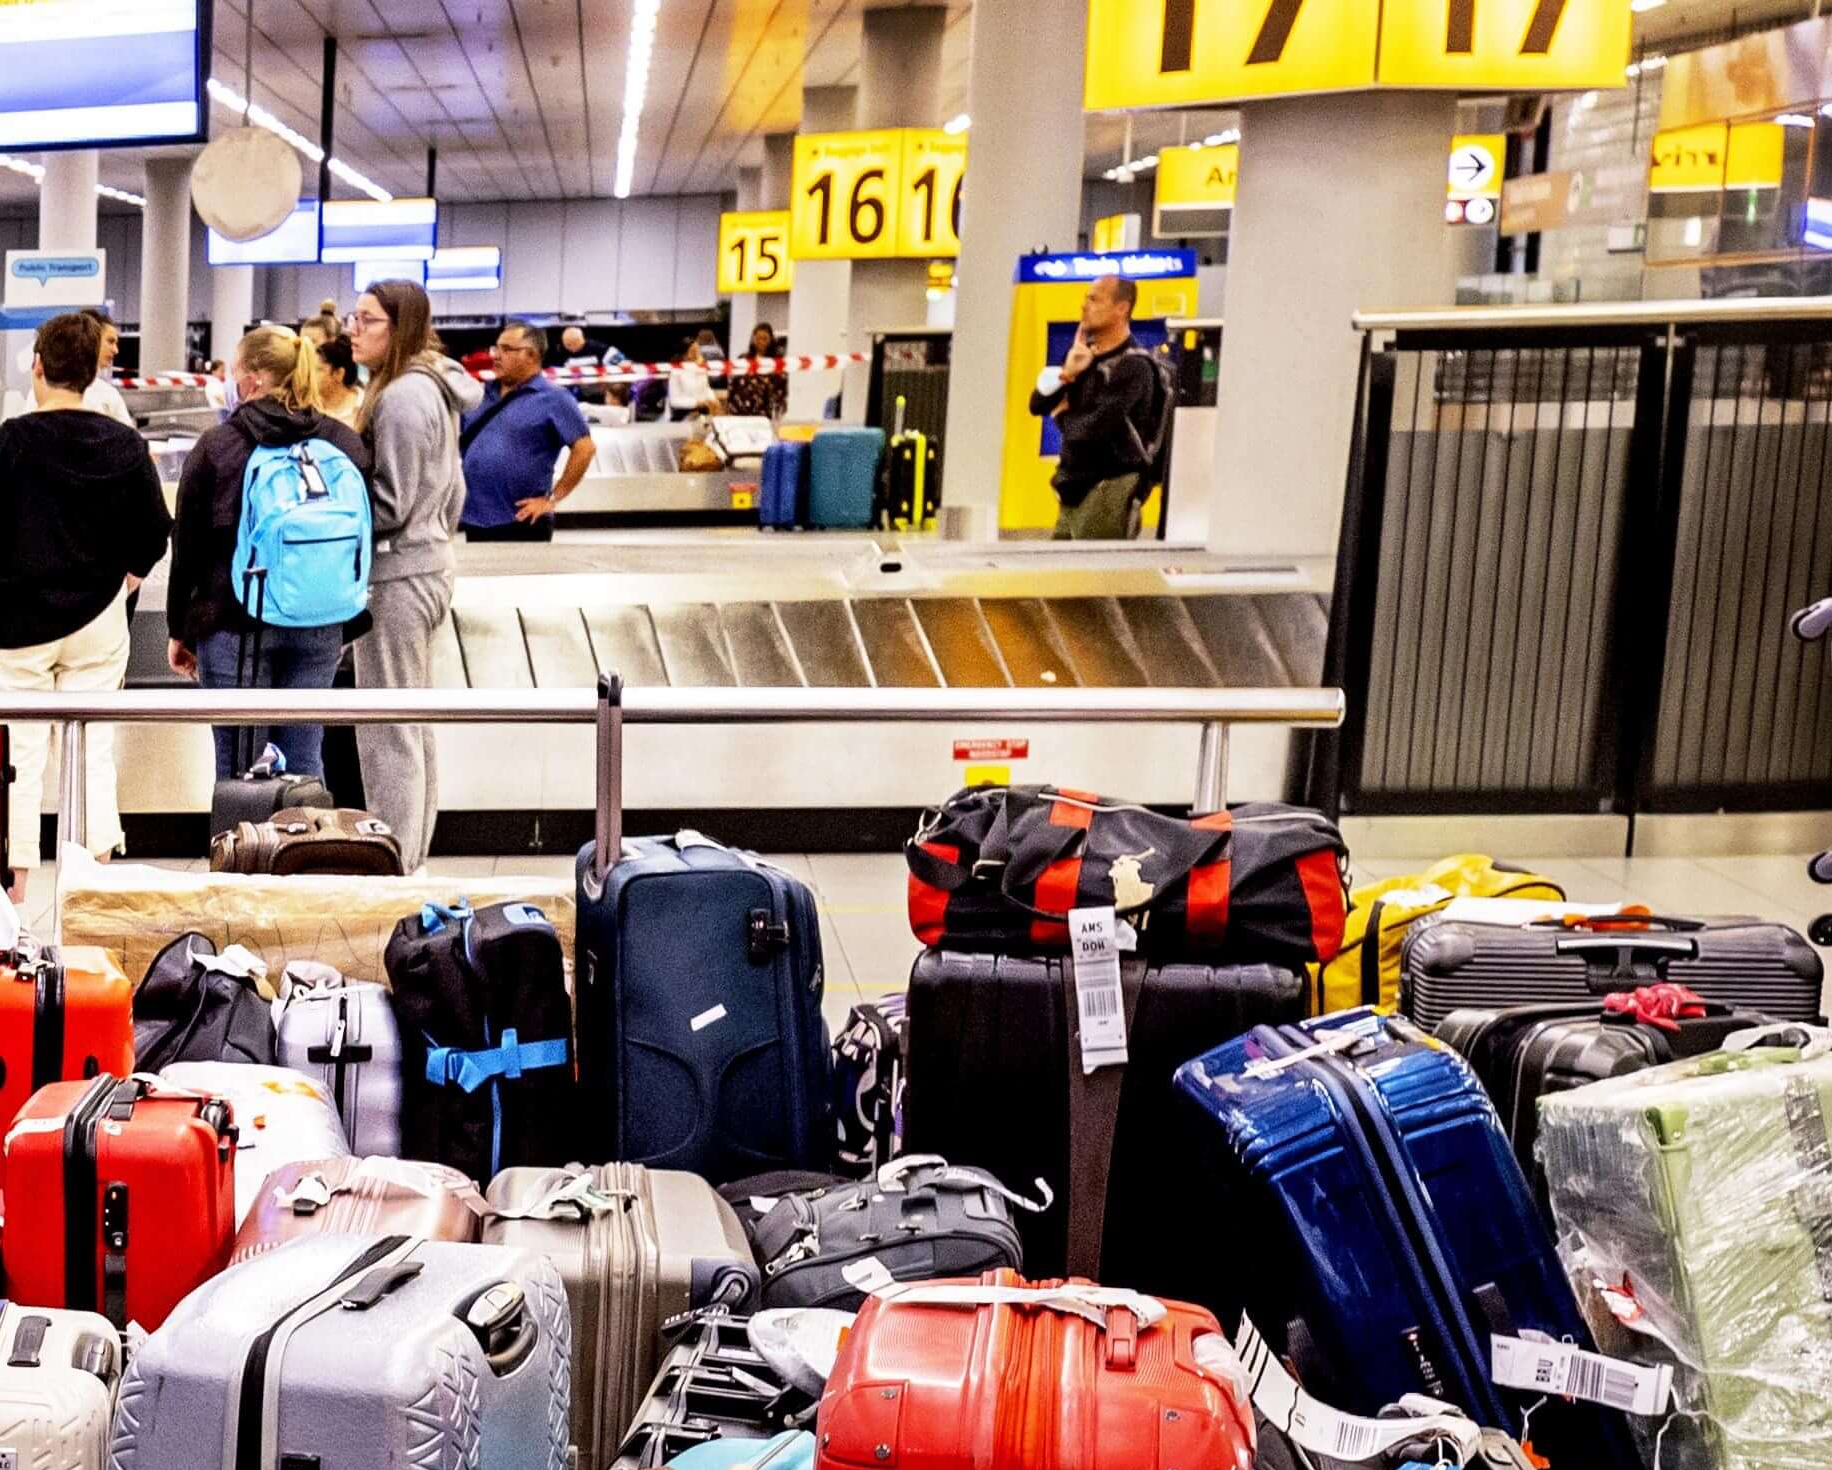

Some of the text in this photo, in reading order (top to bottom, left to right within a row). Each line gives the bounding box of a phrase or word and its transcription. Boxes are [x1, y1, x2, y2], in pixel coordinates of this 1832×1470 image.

[807, 169, 885, 245] 16
[18, 263, 92, 272] Public Transport
[731, 237, 778, 282] 15
[1073, 254, 1183, 275] Train tickets
[1081, 920, 1103, 934] AMS
[1081, 940, 1106, 952] DOH
